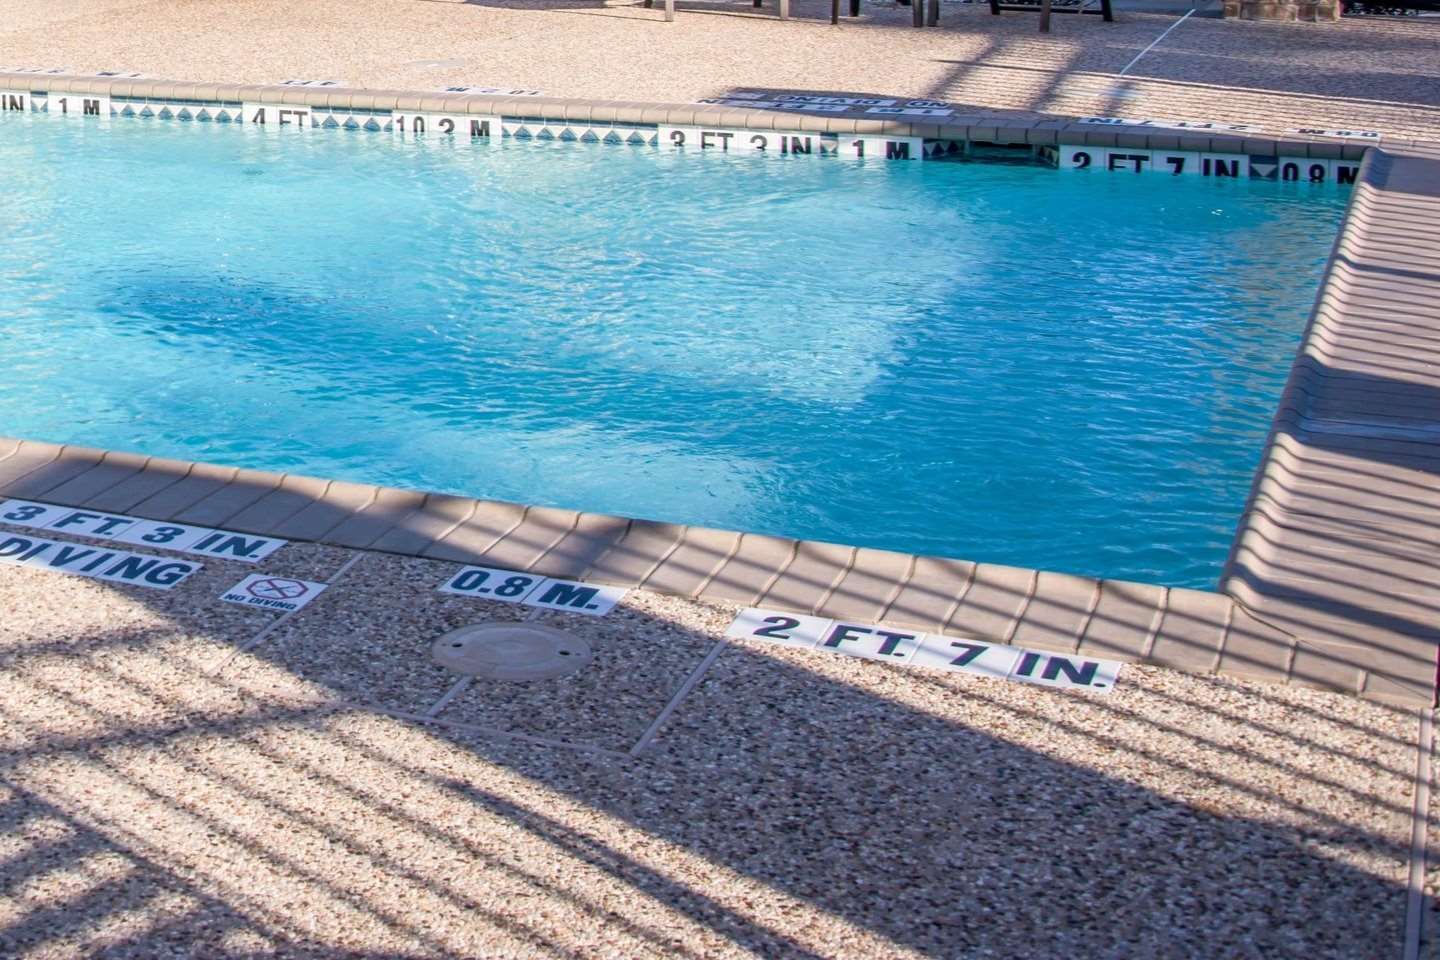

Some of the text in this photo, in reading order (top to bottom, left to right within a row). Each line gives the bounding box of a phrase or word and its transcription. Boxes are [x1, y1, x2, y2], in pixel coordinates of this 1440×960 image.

[2, 94, 24, 111] IN
[58, 97, 68, 114] 1
[278, 110, 307, 127] FT
[700, 132, 734, 150] FT
[781, 136, 811, 154] IN
[852, 140, 865, 157] 1
[1072, 152, 1239, 178] 2 FT 7 IN
[3, 504, 268, 559] 3 FT. 3 IN.
[450, 569, 601, 610] 0.8 M.
[224, 593, 298, 610] NO DIVING
[753, 615, 1108, 688] 2 FT. 7 IN.
